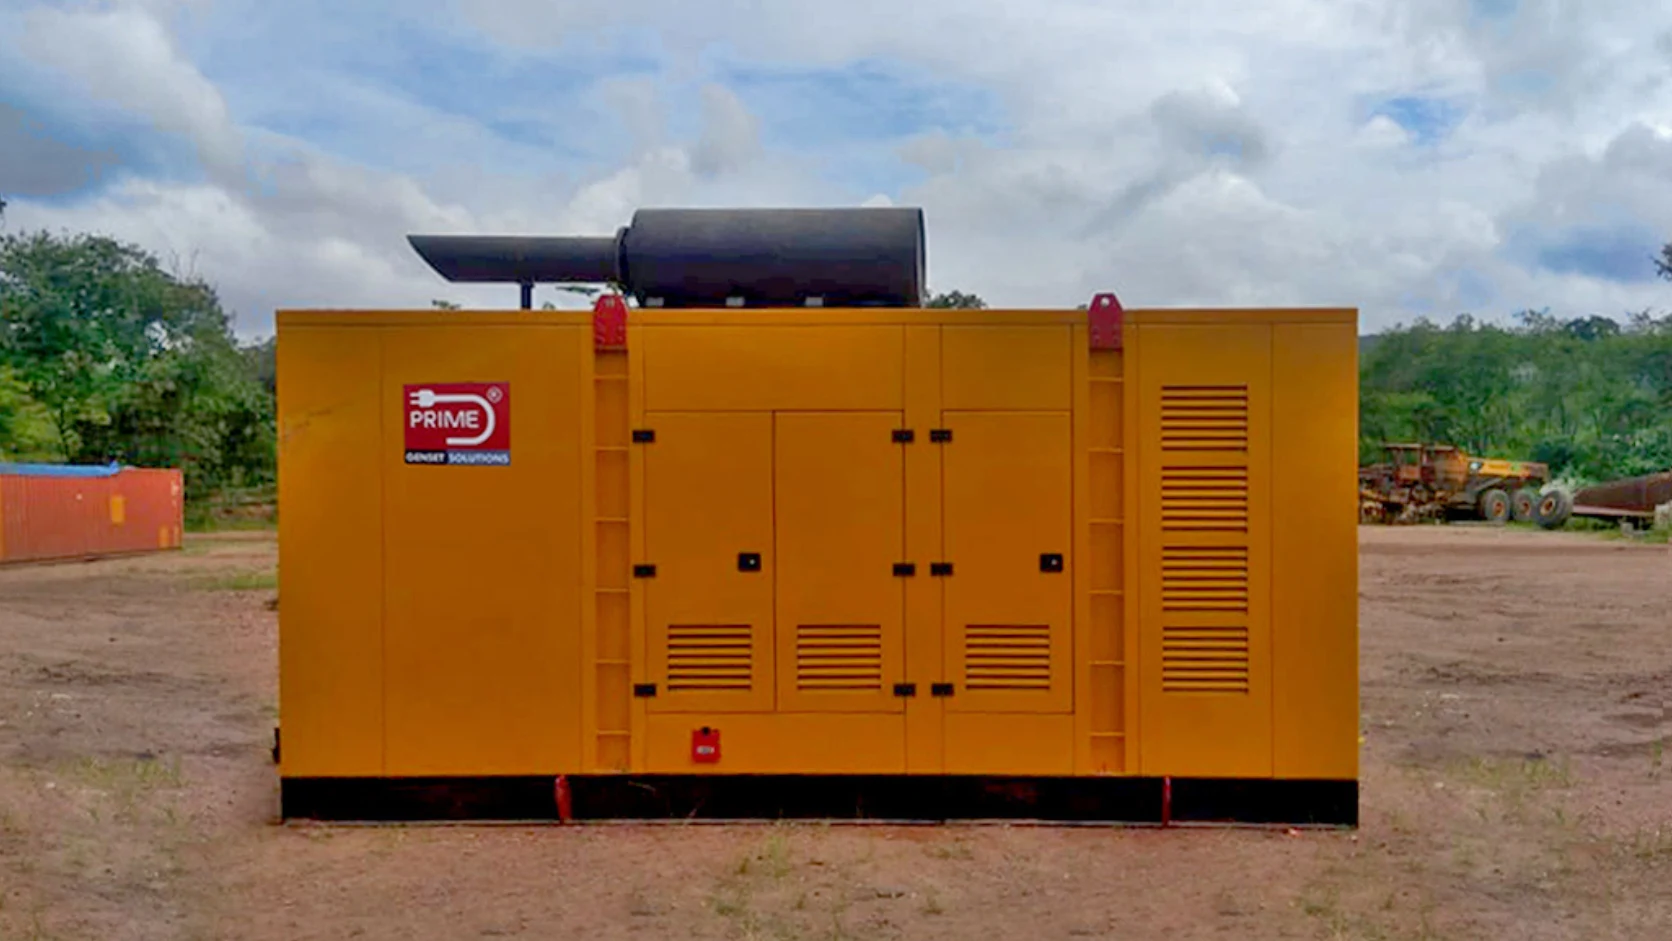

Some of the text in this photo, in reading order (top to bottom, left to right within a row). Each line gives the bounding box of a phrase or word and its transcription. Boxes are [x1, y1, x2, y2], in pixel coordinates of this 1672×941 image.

[410, 410, 479, 428] PRIME
[405, 452, 509, 463] GENSET SOLUTIONS
